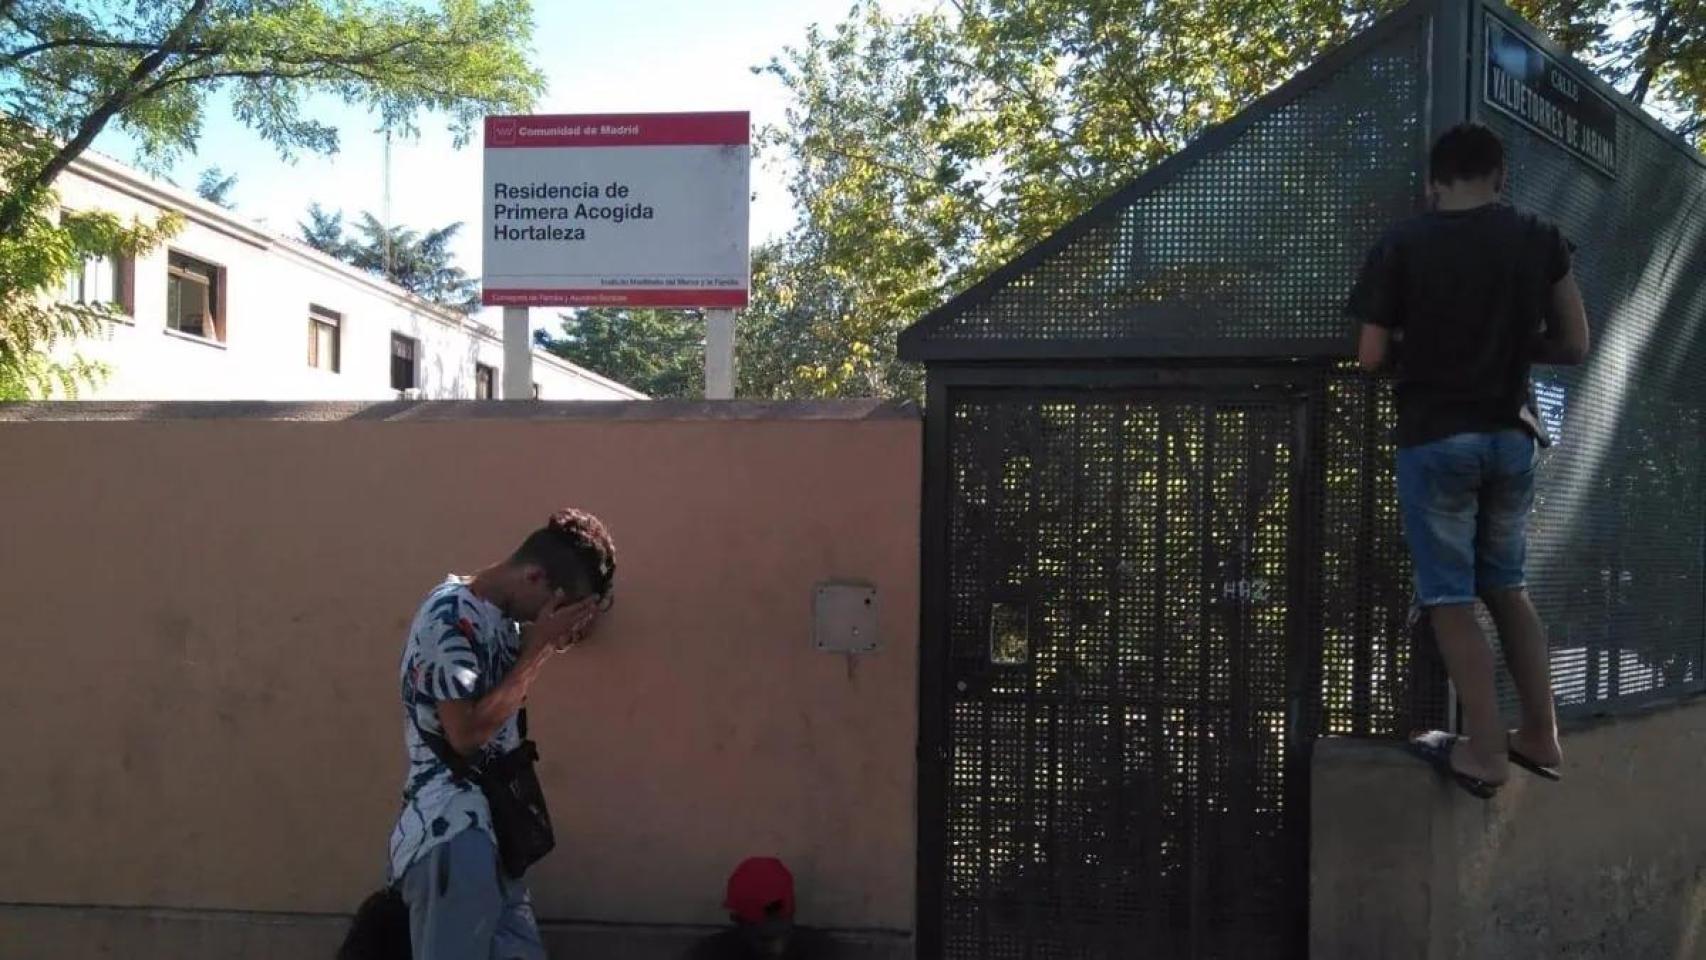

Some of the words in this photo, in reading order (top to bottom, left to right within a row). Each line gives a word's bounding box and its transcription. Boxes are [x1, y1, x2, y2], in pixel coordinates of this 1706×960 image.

[1551, 69, 1579, 103] CALLE
[1493, 66, 1563, 139] VALDETORRES
[1566, 113, 1579, 148] DE
[1581, 124, 1614, 170] JARAMA
[518, 125, 580, 137] Comunidad
[584, 126, 598, 136] de
[600, 124, 639, 136] Madrid
[494, 182, 599, 199] Residencia
[605, 182, 629, 199] de
[494, 204, 568, 220] Primera
[574, 203, 654, 223] Acogida
[494, 225, 586, 241] Hortaleza
